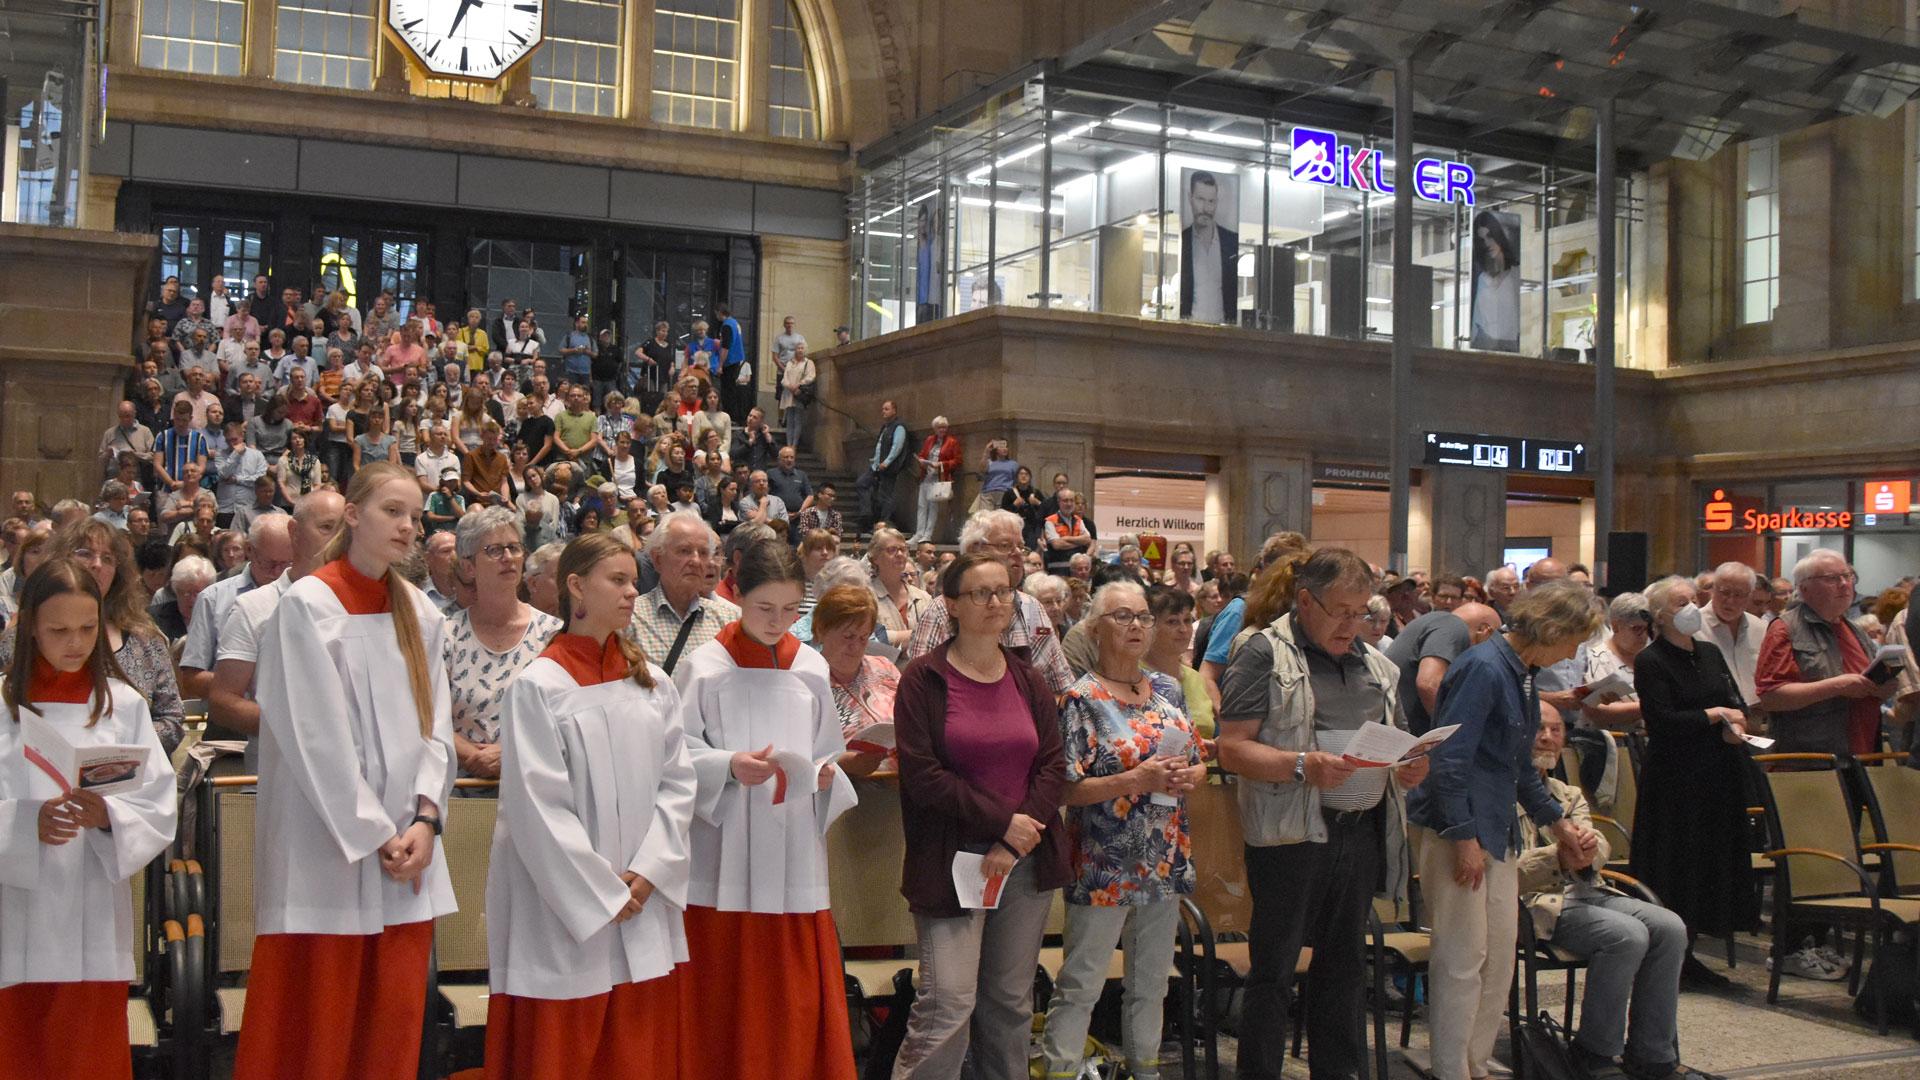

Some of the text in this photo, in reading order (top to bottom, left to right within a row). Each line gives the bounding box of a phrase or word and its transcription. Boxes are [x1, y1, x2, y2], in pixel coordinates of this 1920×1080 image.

[1341, 145, 1476, 207] KLER
[1116, 516, 1160, 529] Herzlich
[1743, 507, 1851, 534] Sparkasse
